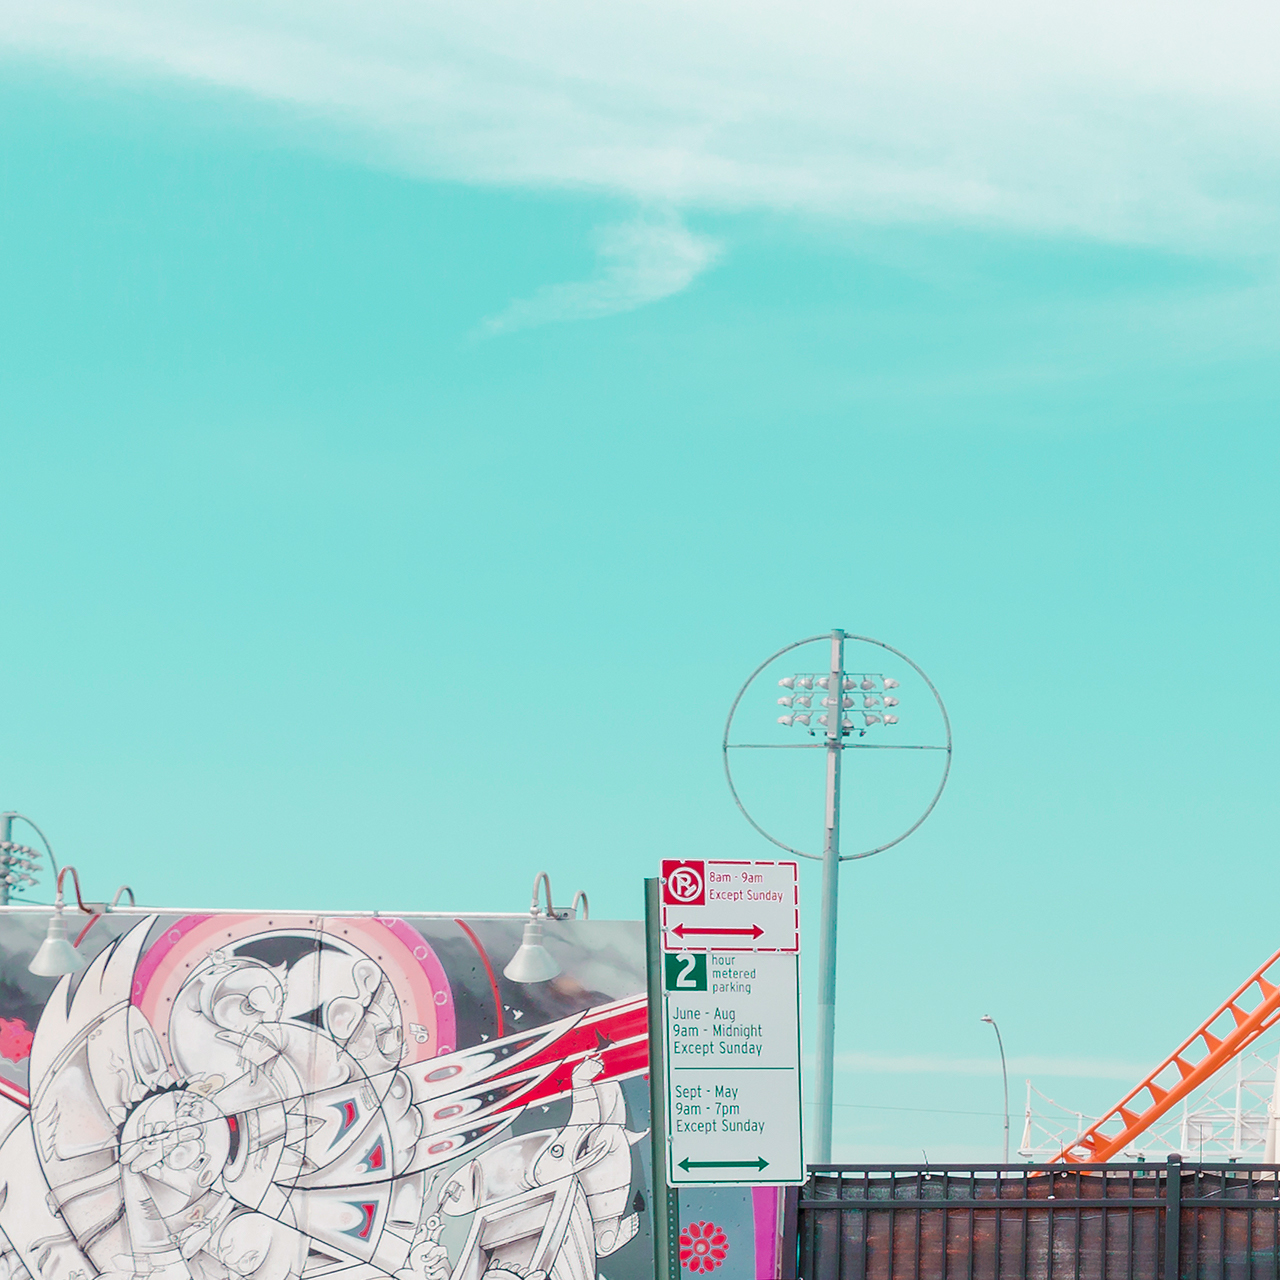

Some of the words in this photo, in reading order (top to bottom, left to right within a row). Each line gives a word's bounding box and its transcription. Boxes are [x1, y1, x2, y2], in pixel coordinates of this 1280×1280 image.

[709, 872, 731, 883] 8am
[741, 872, 763, 883] 9am
[709, 889, 743, 901] Except
[746, 889, 784, 903] Sunday
[711, 954, 736, 965] hour
[675, 953, 697, 988] 2
[712, 968, 756, 979] metered
[712, 981, 752, 995] parking
[672, 1006, 701, 1020] June
[713, 1007, 736, 1023] Aug
[673, 1023, 699, 1037] 9am
[712, 1024, 763, 1040] Midnight
[673, 1041, 715, 1056] Except
[719, 1041, 763, 1056] Sunday
[675, 1085, 702, 1100] Sept
[714, 1085, 739, 1100] May
[675, 1102, 702, 1116] 9am
[714, 1102, 740, 1117] 7pm
[676, 1119, 717, 1134] Except
[721, 1119, 766, 1134] Sunday
